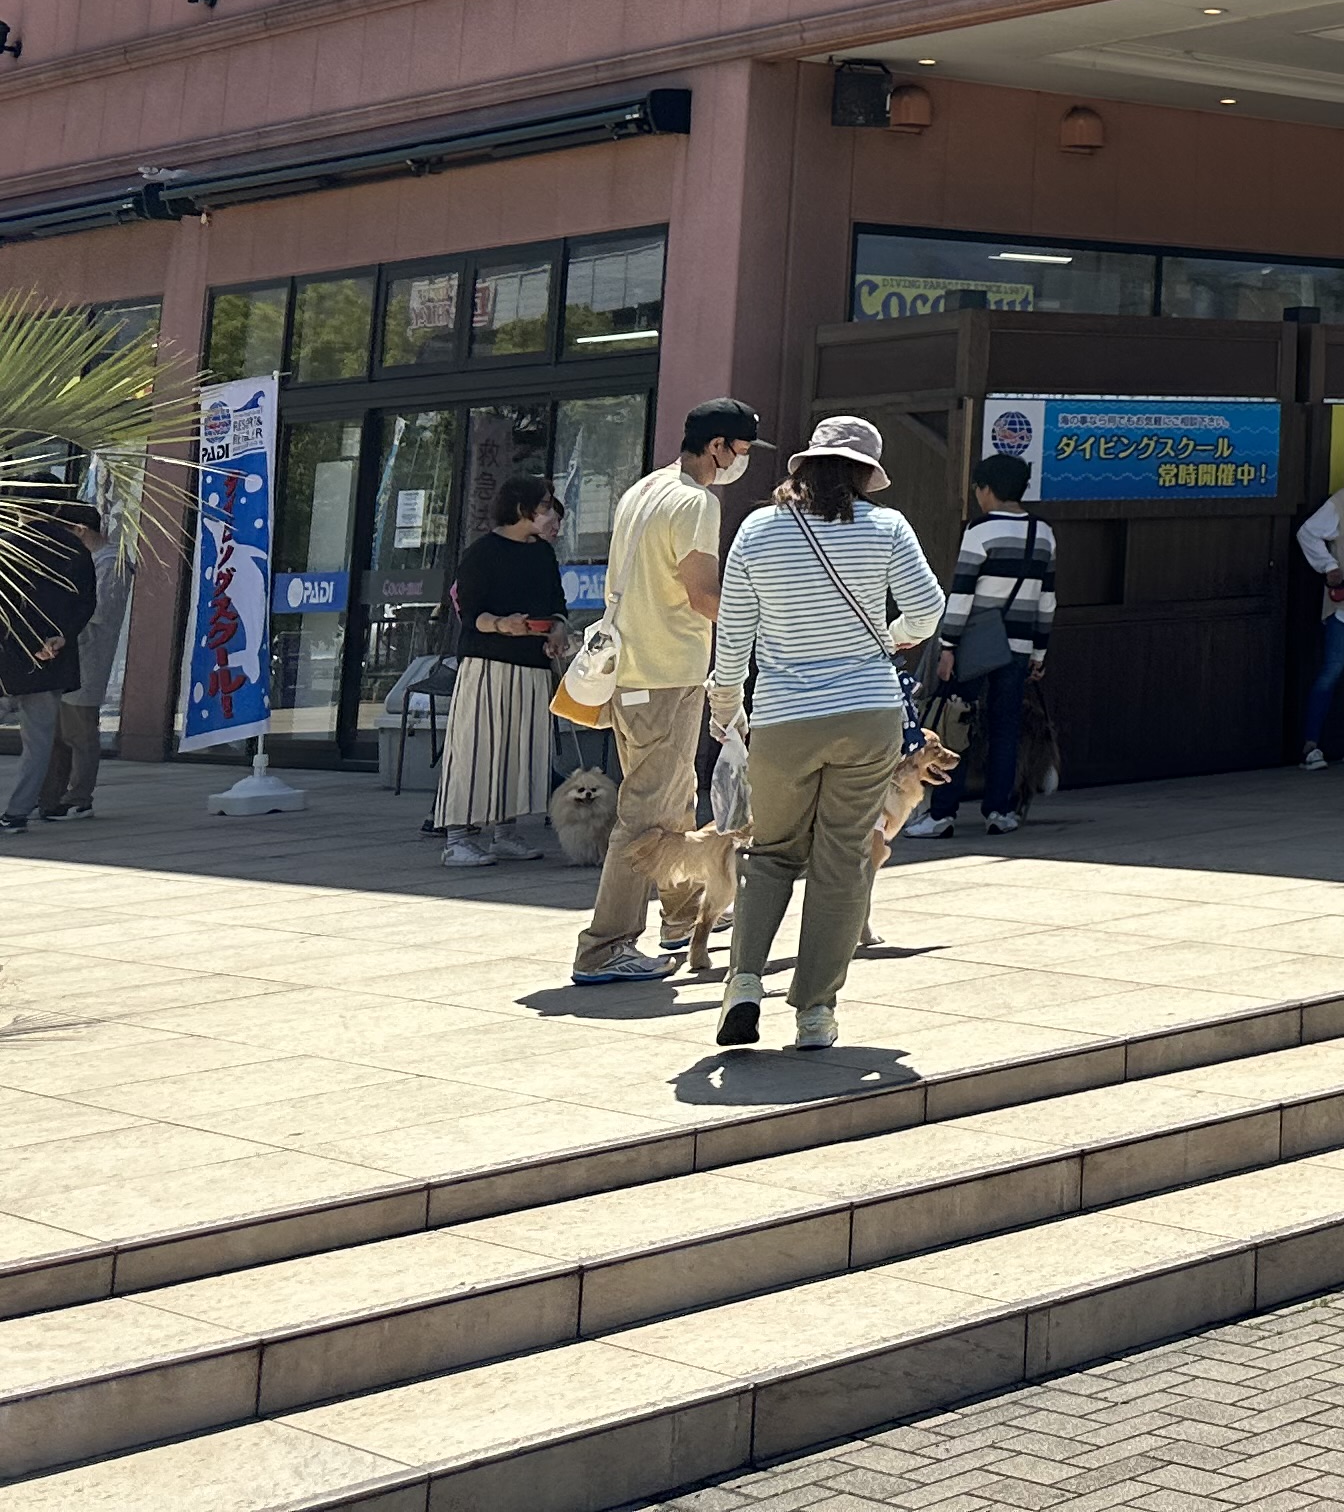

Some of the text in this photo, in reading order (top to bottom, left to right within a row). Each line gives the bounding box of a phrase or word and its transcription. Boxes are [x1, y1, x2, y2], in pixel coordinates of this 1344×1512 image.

[882, 278, 921, 288] DIVING
[201, 444, 229, 463] PADI
[1057, 436, 1234, 459] ダイビングスクール
[303, 581, 334, 604] PADI
